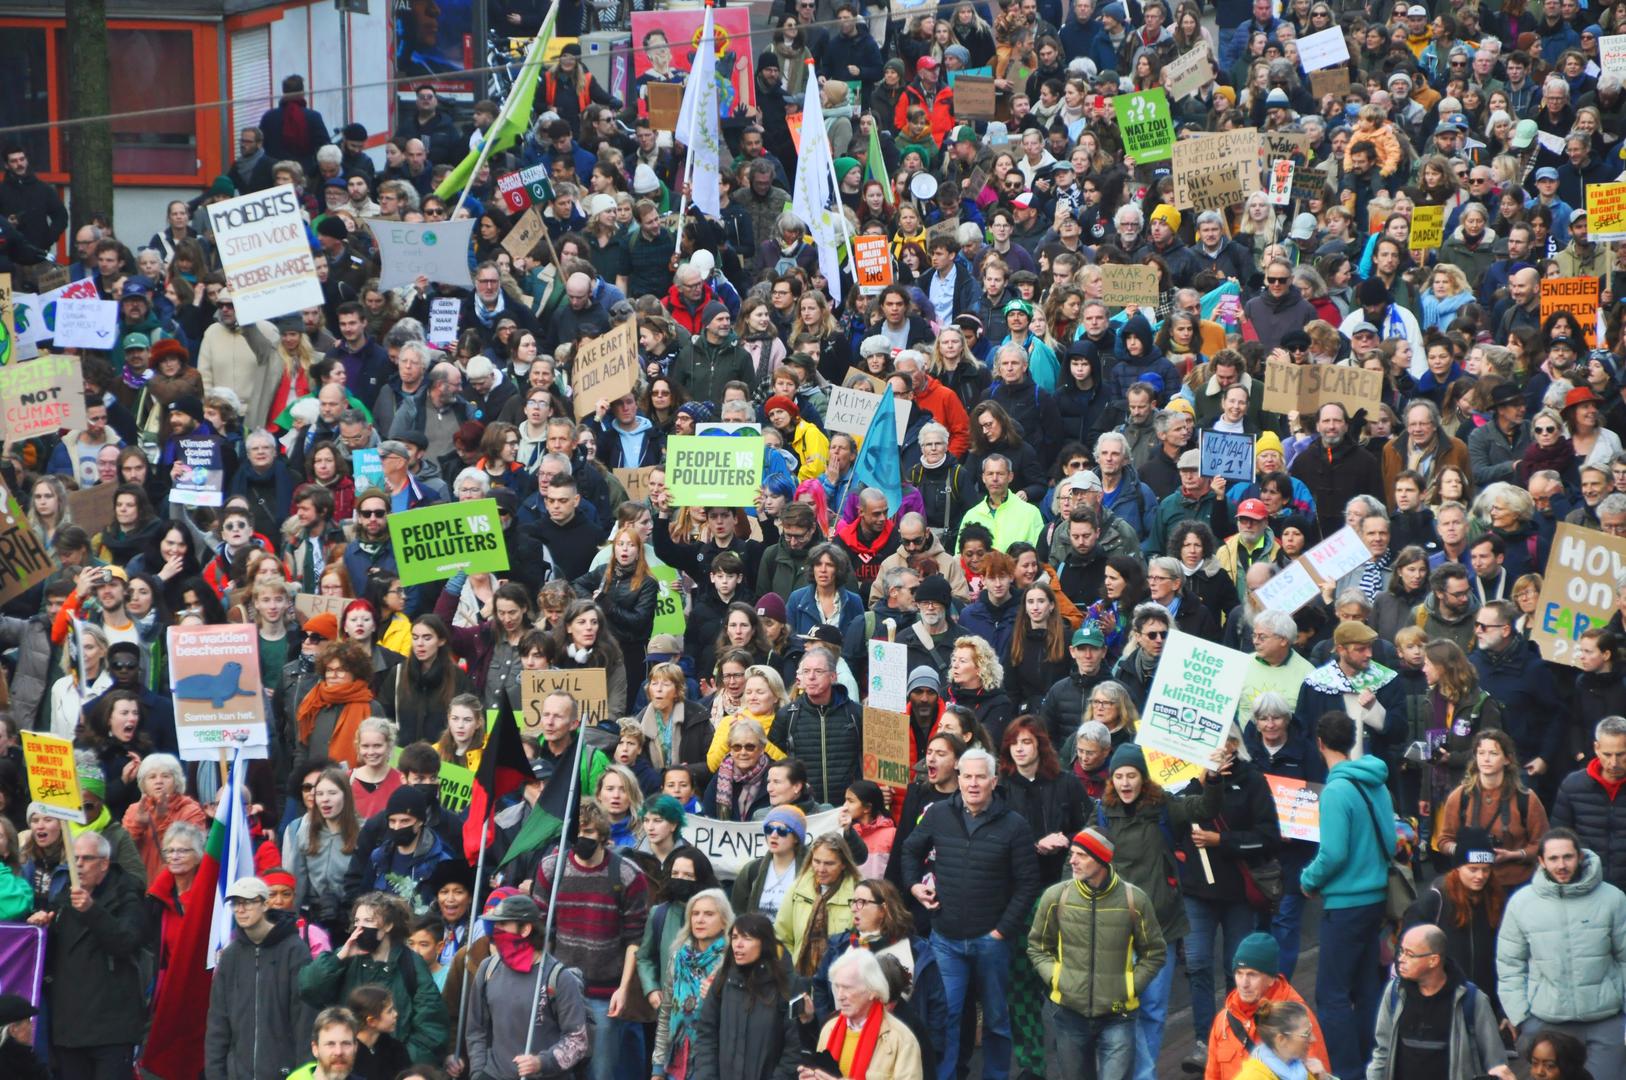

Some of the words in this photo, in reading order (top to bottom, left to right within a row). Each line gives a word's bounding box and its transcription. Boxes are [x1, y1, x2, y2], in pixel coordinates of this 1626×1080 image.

[1124, 122, 1145, 136] WAT
[1146, 118, 1167, 131] ZOU
[1155, 129, 1169, 138] MET
[1217, 132, 1255, 148] GEVAAR
[262, 223, 299, 244] VOOR
[1412, 228, 1439, 242] DADEN!
[274, 253, 313, 279] AARDE
[1103, 267, 1142, 279] WAAR
[864, 271, 884, 282] ING
[1542, 279, 1597, 297] SNOEPJES
[599, 326, 631, 357] EARTH
[602, 343, 637, 380] AGAIN
[1266, 361, 1303, 396] I'M
[1307, 366, 1379, 401] SCARED
[20, 387, 62, 406] NOT
[7, 403, 70, 422] CLIMATE
[15, 417, 62, 433] CHANGE
[179, 439, 216, 448] Klimaat-
[184, 447, 213, 457] doelen
[676, 450, 732, 468] PEOPLE
[735, 451, 754, 469] VS
[1210, 458, 1223, 470] OP
[672, 469, 756, 486] POLLUTERS
[400, 518, 465, 545] PEOPLE
[466, 514, 490, 534] VS
[402, 533, 498, 564] POLLUTERS
[1312, 535, 1346, 564] NIET
[1567, 576, 1613, 610] on
[178, 633, 197, 644] De
[199, 632, 248, 644] wadden
[175, 645, 253, 657] beschermen
[1191, 648, 1224, 669] kies
[1183, 659, 1220, 678] voor
[1183, 670, 1212, 688] een
[1162, 684, 1224, 714] klimaat
[1184, 683, 1232, 705] ander
[183, 712, 217, 722] Samen
[217, 712, 237, 721] kan
[237, 711, 255, 720] het.
[1154, 704, 1178, 715] stem
[1200, 718, 1221, 730] voor
[27, 742, 42, 752] EEN
[44, 743, 69, 755] BETER
[36, 754, 63, 766] MILIEU
[31, 765, 58, 777] BEGINT
[59, 769, 72, 780] BIJ
[694, 827, 765, 859] PLANE
